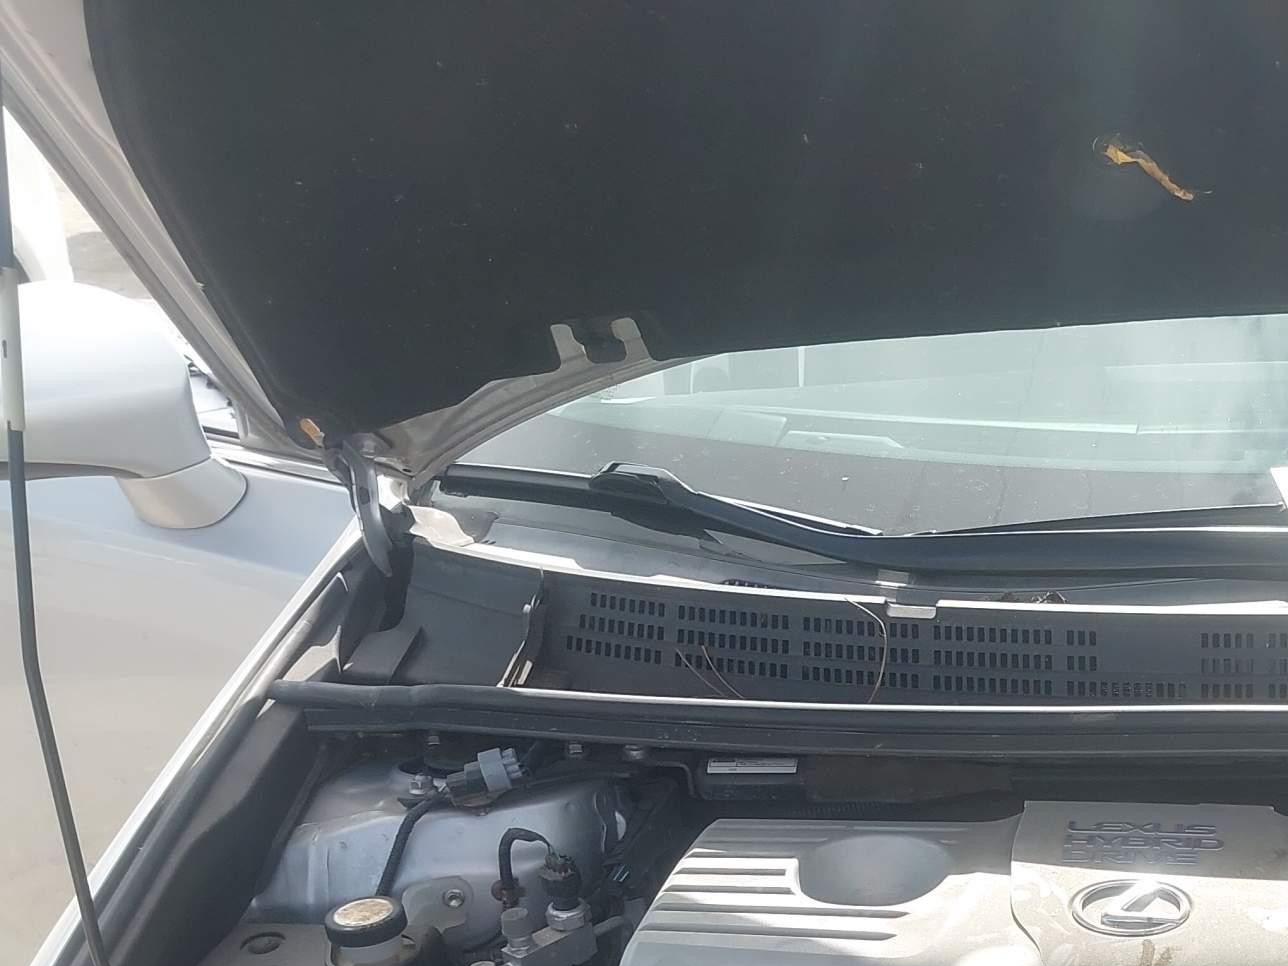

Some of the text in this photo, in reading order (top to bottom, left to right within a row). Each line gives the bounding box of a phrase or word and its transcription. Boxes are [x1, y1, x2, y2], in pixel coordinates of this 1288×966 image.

[1067, 820, 1217, 837] LEXUS
[1063, 834, 1224, 851] HYBRID
[1062, 850, 1200, 865] DRIVE
